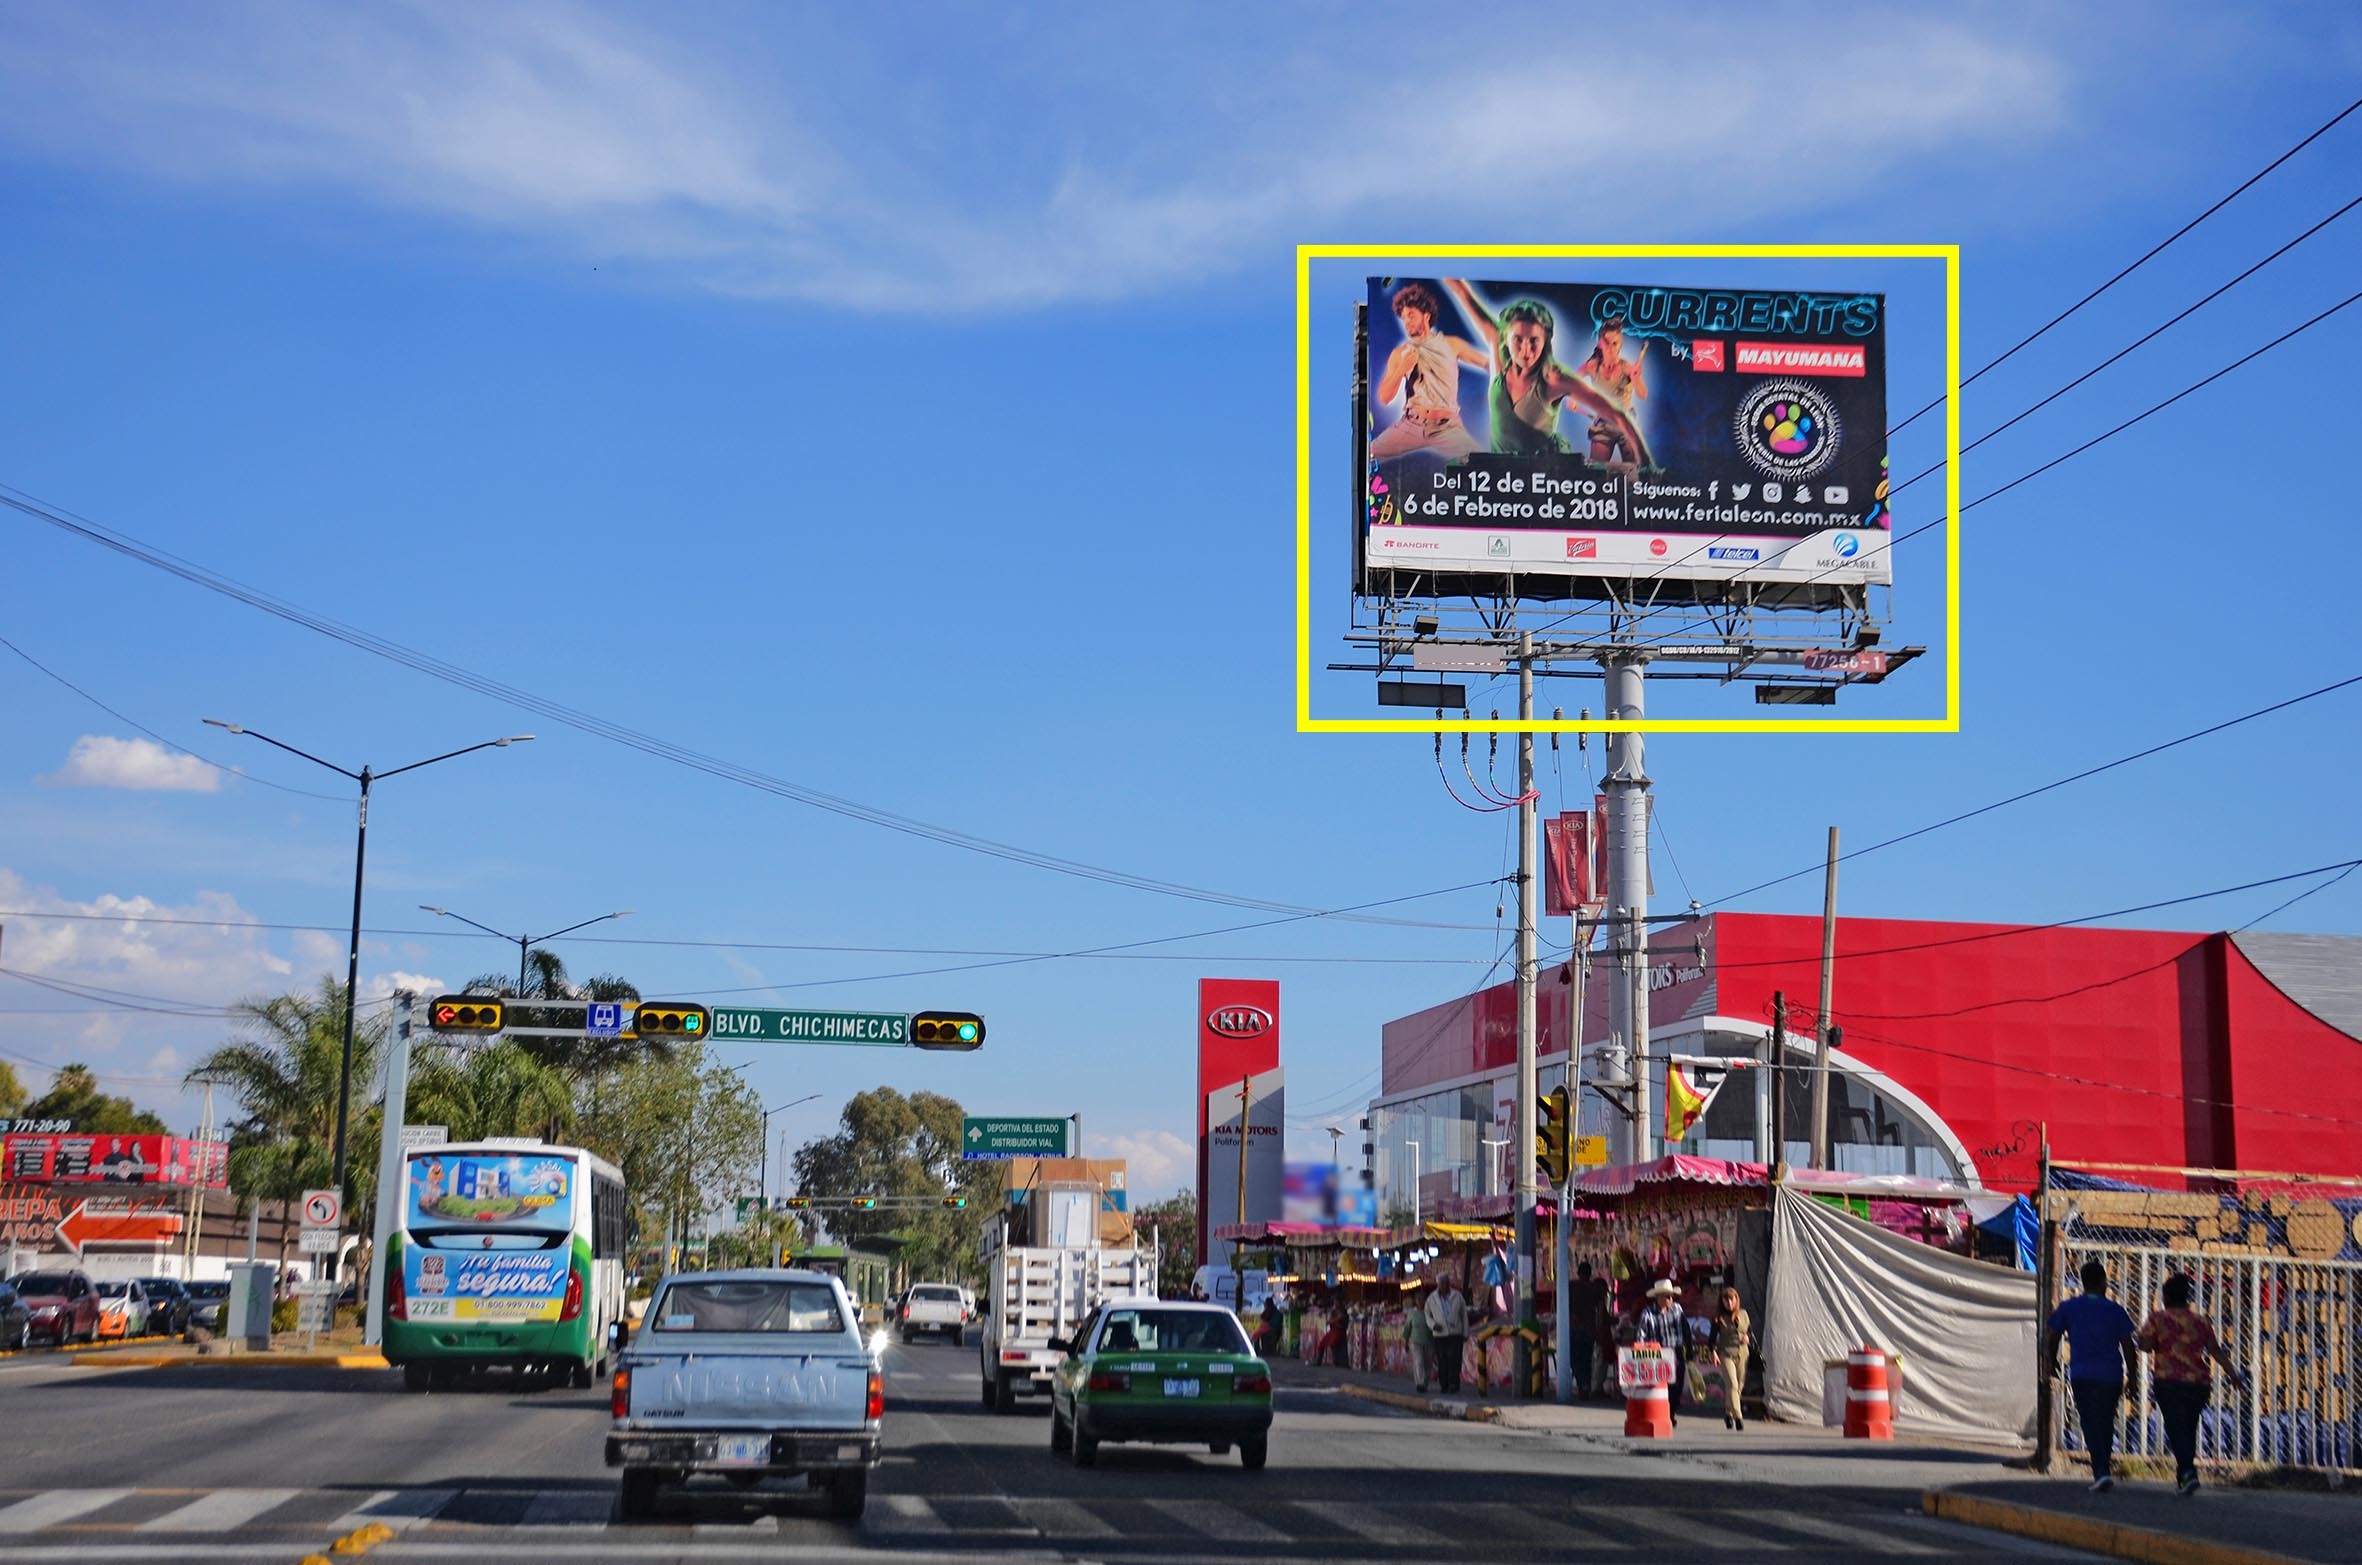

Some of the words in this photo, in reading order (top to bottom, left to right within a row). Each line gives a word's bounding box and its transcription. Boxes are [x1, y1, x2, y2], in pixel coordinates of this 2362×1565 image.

[1589, 288, 1878, 336] CURRENTS
[1671, 344, 1687, 361] by
[1738, 349, 1865, 368] MAYUMANA
[1433, 472, 1460, 489] Del
[1468, 471, 1491, 493] 12
[1497, 472, 1525, 493] de
[1531, 473, 1597, 495] Enero
[1602, 477, 1618, 494] al
[1632, 481, 1701, 500] Síguenos:
[1404, 493, 1418, 515] 6
[1422, 494, 1449, 516] de
[1454, 495, 1534, 519] Febrero
[1538, 497, 1566, 519] de
[1569, 499, 1619, 520] 2018
[1633, 502, 1861, 528] www.ferialeon.com.mx
[1396, 540, 1440, 550] BANORTE
[1816, 559, 1878, 570] MEGACABLE
[716, 1014, 765, 1036] BLVD.
[780, 1015, 903, 1040] CHICHIMECAS
[1219, 1012, 1261, 1031] KIA
[13, 1119, 71, 1132] 771-20-90
[987, 1123, 1021, 1134] DEPORTIVA
[1022, 1124, 1034, 1134] DEL
[1034, 1124, 1060, 1134] ESTADO
[1214, 1126, 1232, 1135] KIA
[991, 1138, 1038, 1148] DISTRIBUIDOR
[1039, 1138, 1053, 1148] VIAL
[490, 1254, 554, 1272] familia
[456, 1268, 566, 1298] segura!
[412, 1301, 450, 1316] 272E
[1622, 1361, 1672, 1383] $50
[663, 1370, 837, 1403] NISSAN
[643, 1410, 685, 1418] DATSUN
